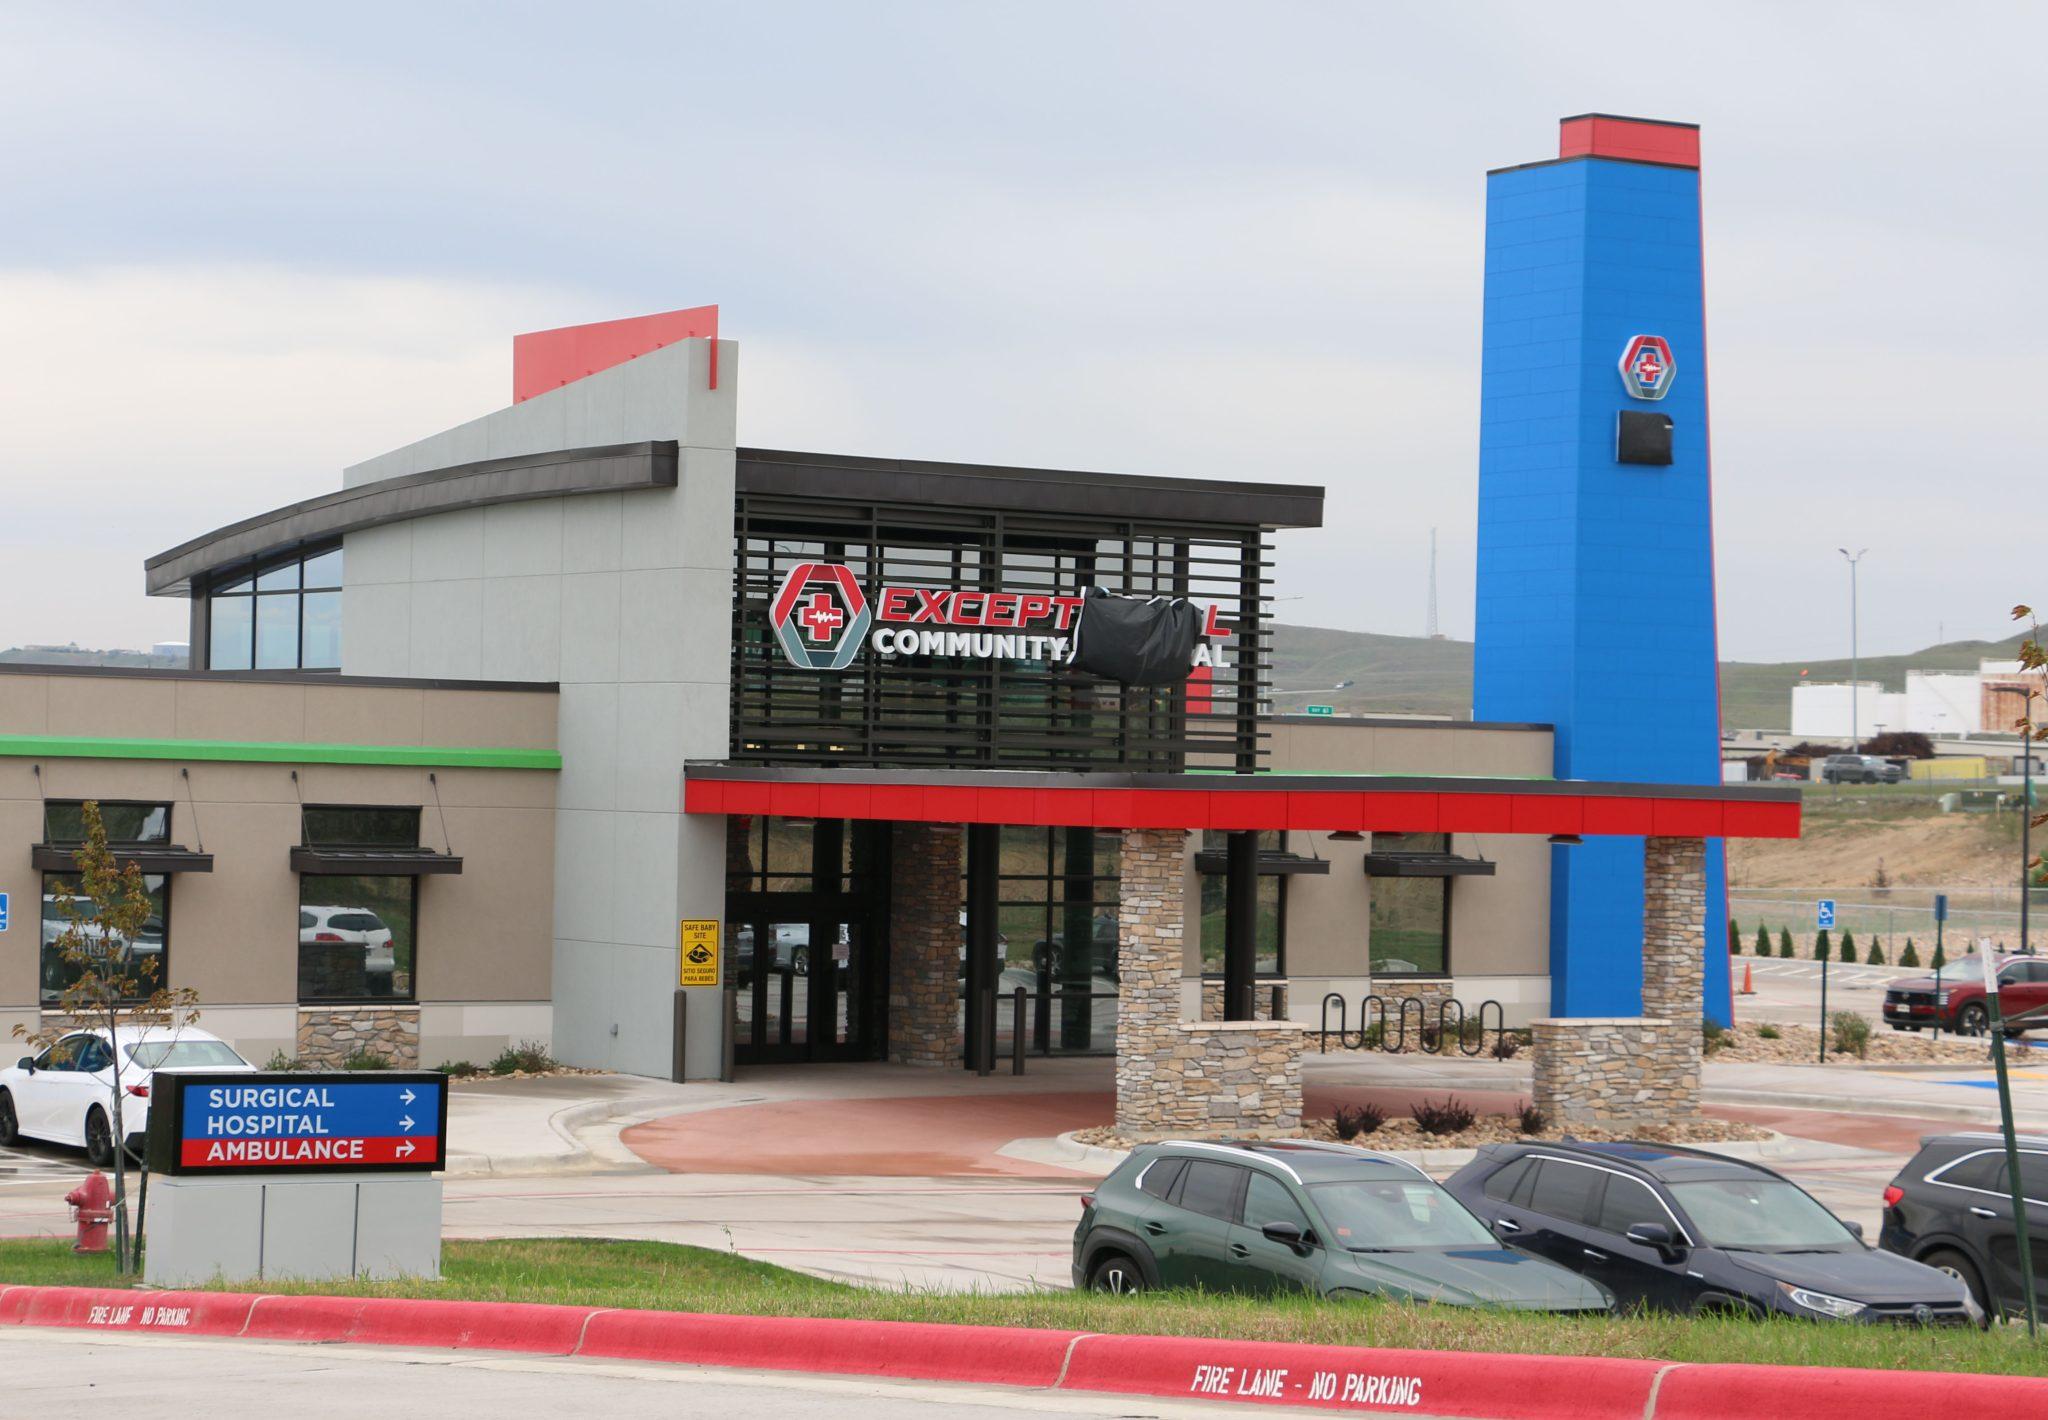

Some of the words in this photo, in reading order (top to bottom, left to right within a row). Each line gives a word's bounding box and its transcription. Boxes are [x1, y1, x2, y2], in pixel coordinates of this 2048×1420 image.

[872, 628, 1069, 661] COMMUNITY
[209, 1088, 335, 1108] SURGICAL
[207, 1115, 329, 1135] HOSPITAL
[207, 1140, 364, 1161] AMBULANCE
[87, 1306, 110, 1324] FIRE
[107, 1306, 133, 1325] LANE
[139, 1306, 154, 1325] NO
[154, 1306, 191, 1326] PARKING
[1190, 1365, 1234, 1394] FIRE
[1237, 1368, 1288, 1397] LANE
[1307, 1371, 1336, 1400] NO
[1341, 1373, 1422, 1406] PARKING
